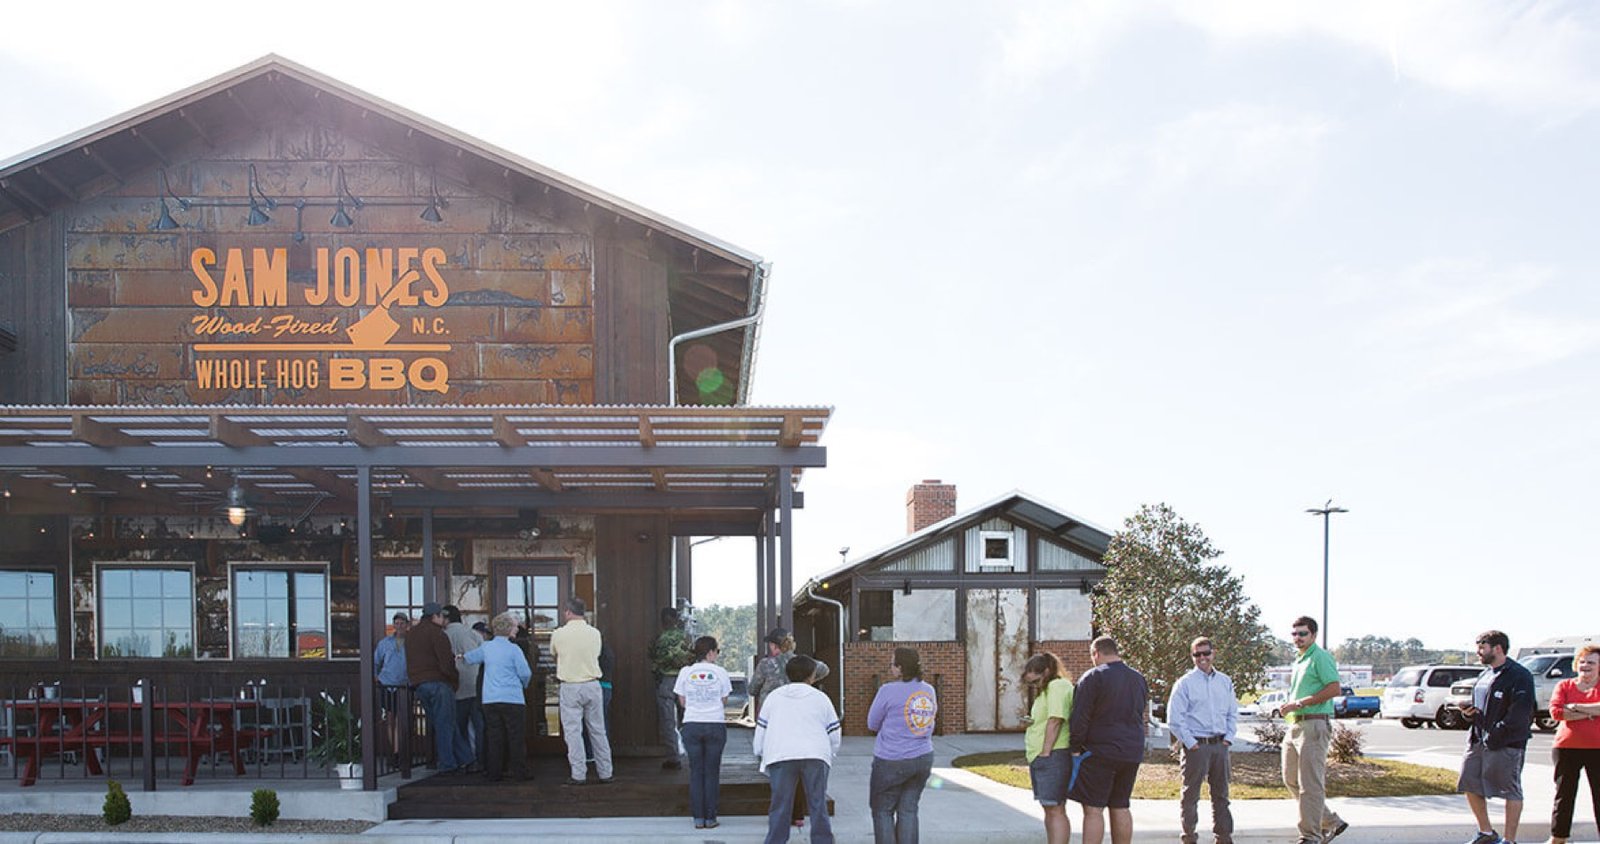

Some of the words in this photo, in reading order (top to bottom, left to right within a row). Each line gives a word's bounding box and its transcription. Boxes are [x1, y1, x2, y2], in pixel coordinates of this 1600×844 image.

[191, 247, 287, 307] SAM
[304, 247, 449, 307] JONES
[191, 314, 338, 338] Wood-Fired
[412, 317, 450, 335] N.C.
[196, 359, 268, 389] WHOLE
[276, 359, 319, 389] HOG
[329, 357, 450, 394] BBQ
